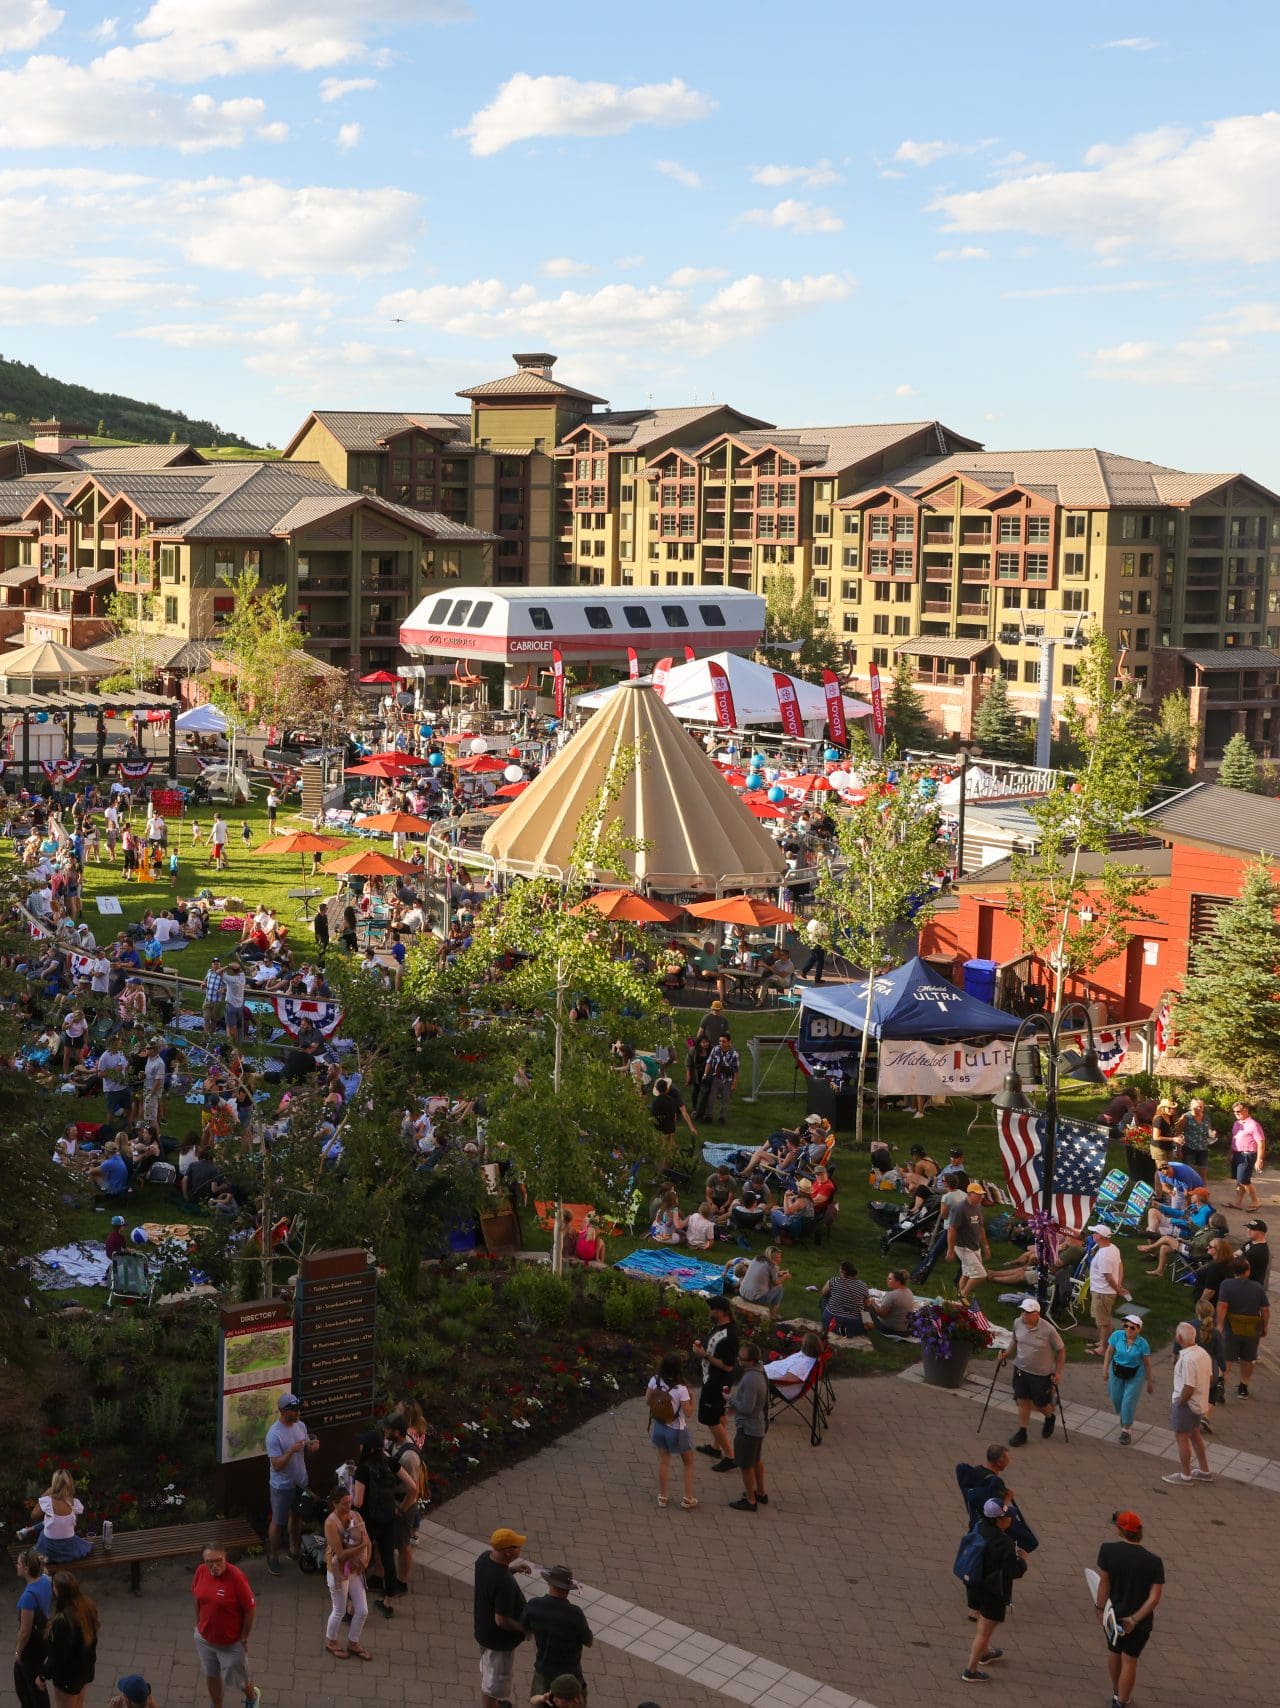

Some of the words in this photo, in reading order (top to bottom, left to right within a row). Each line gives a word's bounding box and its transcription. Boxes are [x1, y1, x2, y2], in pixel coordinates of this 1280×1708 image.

[443, 637, 476, 647] CABRIOLET
[510, 641, 553, 651] CABRIOLET
[719, 694, 730, 728] TOYOT
[874, 693, 883, 729] TOYOTA
[785, 704, 798, 738] TOYOT
[831, 701, 842, 737] TOYOTA
[913, 992, 963, 1001] ULTRA
[884, 1050, 949, 1067] Michelob
[965, 1050, 1012, 1067] ULTR
[1028, 1109, 1043, 1117] CITY
[240, 1310, 277, 1323] DIRECTORY
